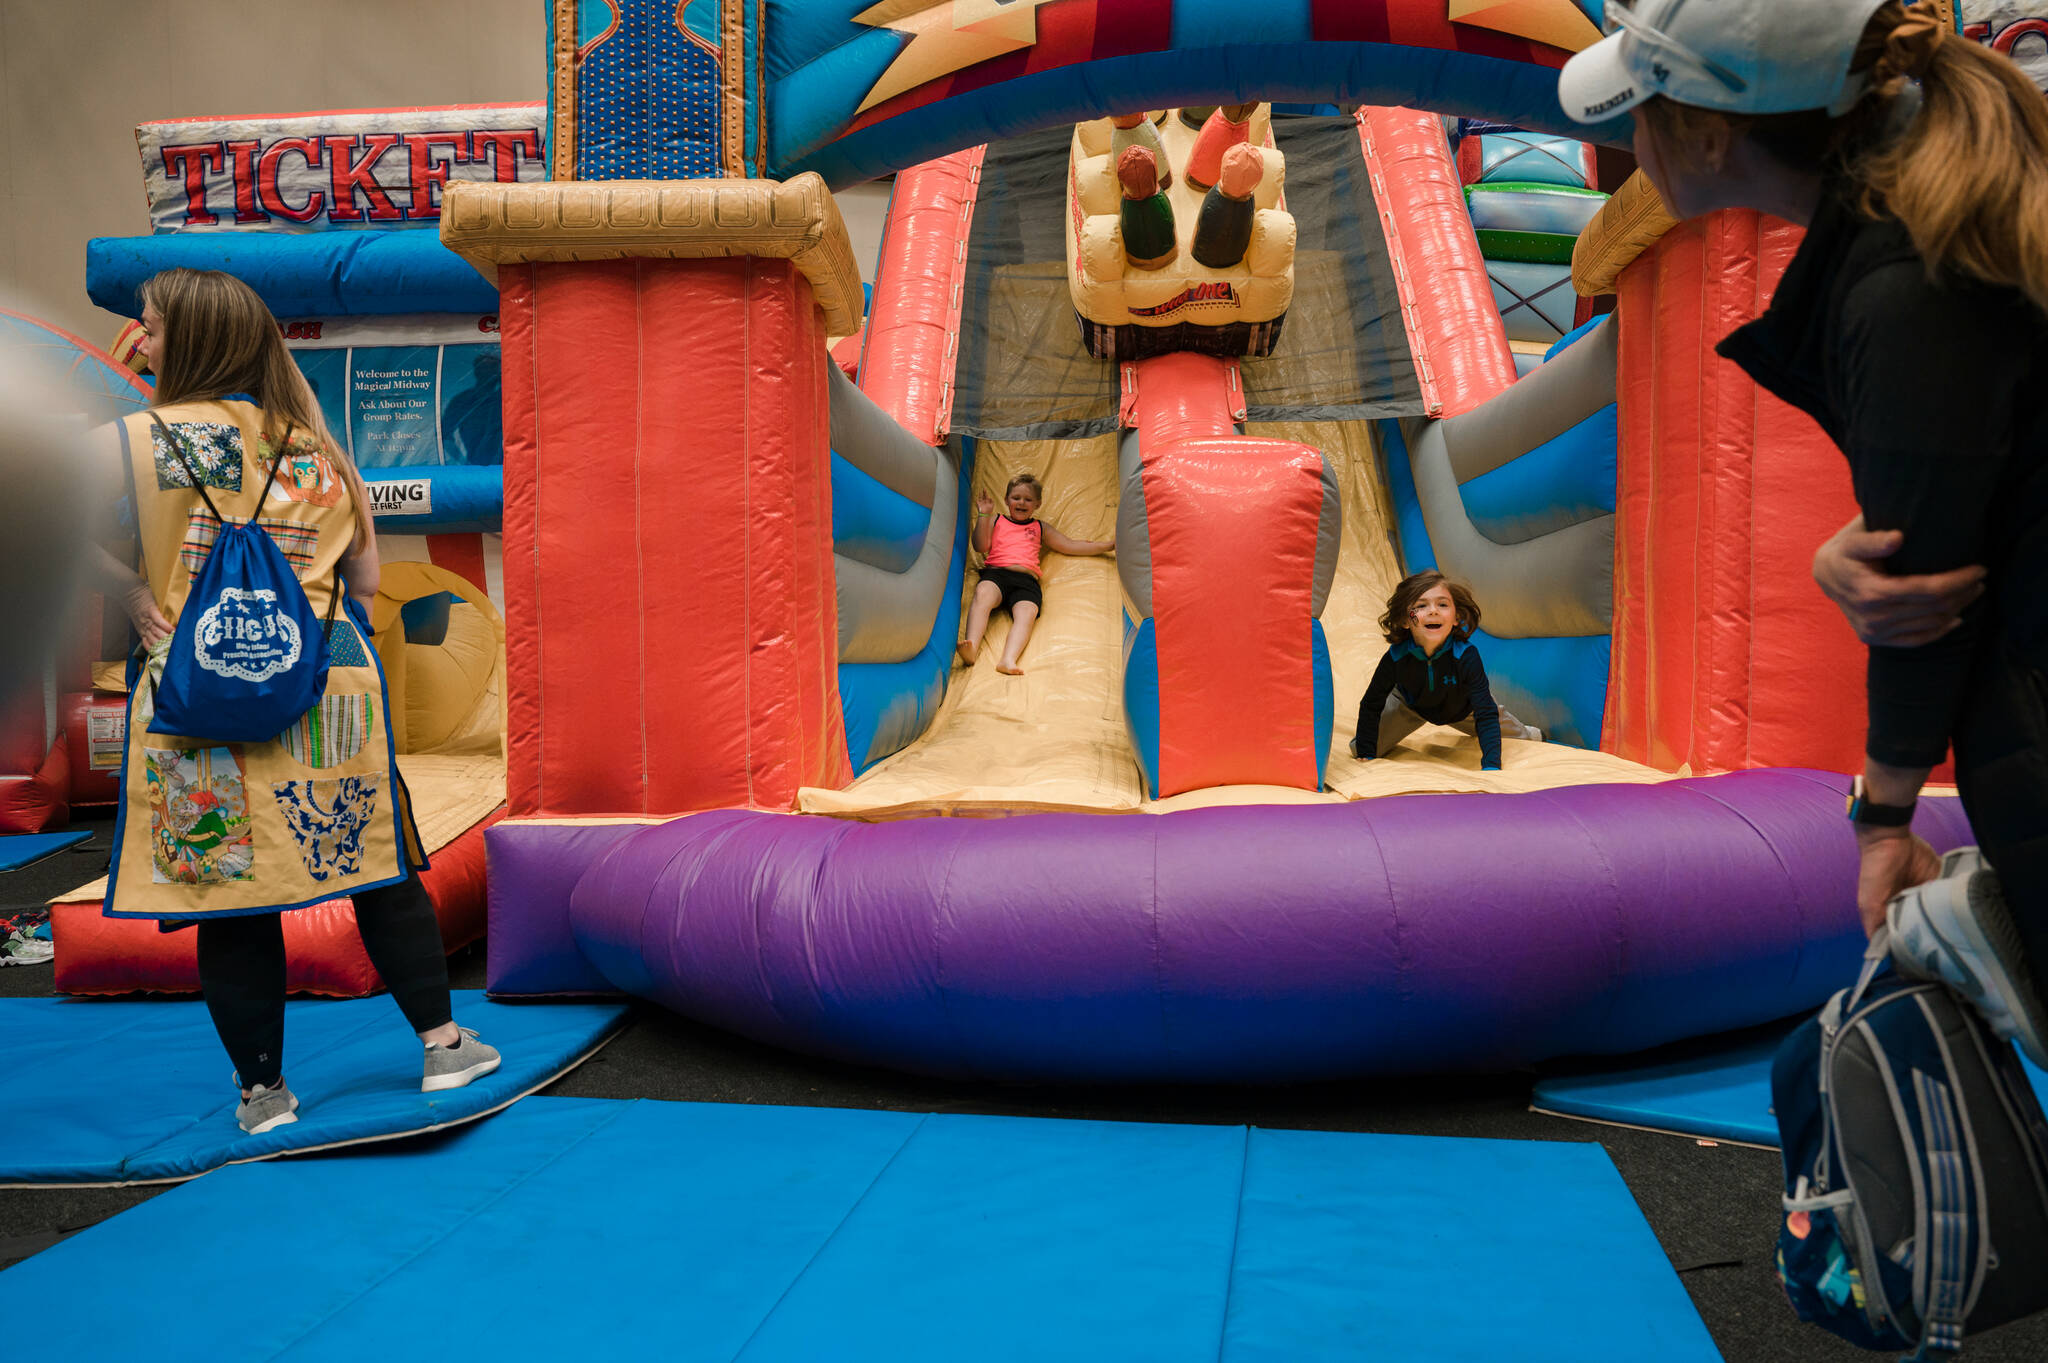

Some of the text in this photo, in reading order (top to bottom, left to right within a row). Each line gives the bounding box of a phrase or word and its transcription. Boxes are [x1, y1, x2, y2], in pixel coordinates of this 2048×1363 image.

[160, 127, 546, 226] TICKET
[1193, 281, 1229, 300] One
[355, 369, 399, 379] Welcome
[413, 368, 429, 377] the
[355, 380, 431, 392] Magical Midway
[358, 399, 427, 409] Ask About Our
[363, 411, 423, 422] Group Rates.
[367, 431, 421, 440] Park Closes
[380, 502, 402, 510] FIRST
